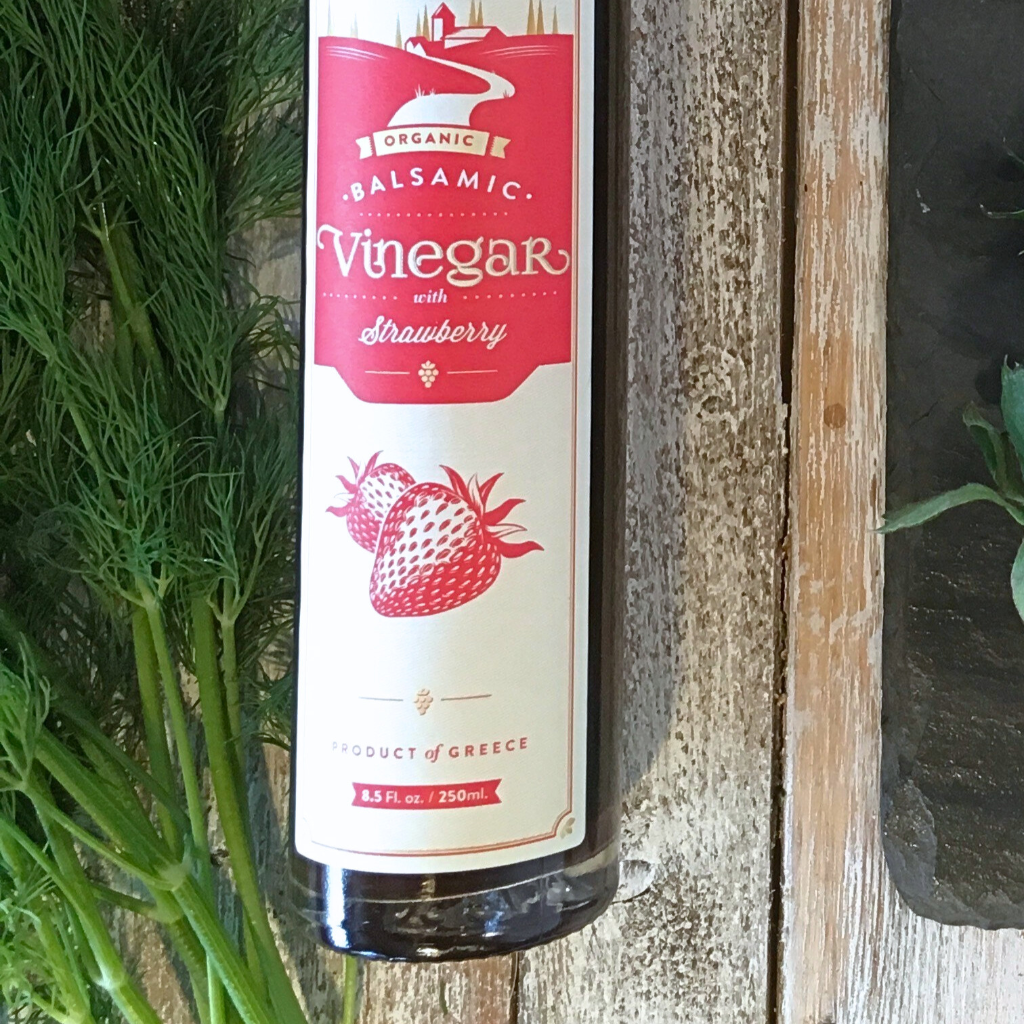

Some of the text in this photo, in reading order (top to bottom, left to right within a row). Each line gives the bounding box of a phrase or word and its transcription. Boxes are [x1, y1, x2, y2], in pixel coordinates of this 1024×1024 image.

[383, 132, 475, 147] ORGANIC
[349, 167, 522, 202] BALSAMIC
[413, 288, 448, 304] with
[358, 315, 508, 350] Strawberry
[331, 737, 529, 763] PRODUCT of GREECE
[361, 789, 383, 803] 8.5
[405, 792, 424, 804] oz.
